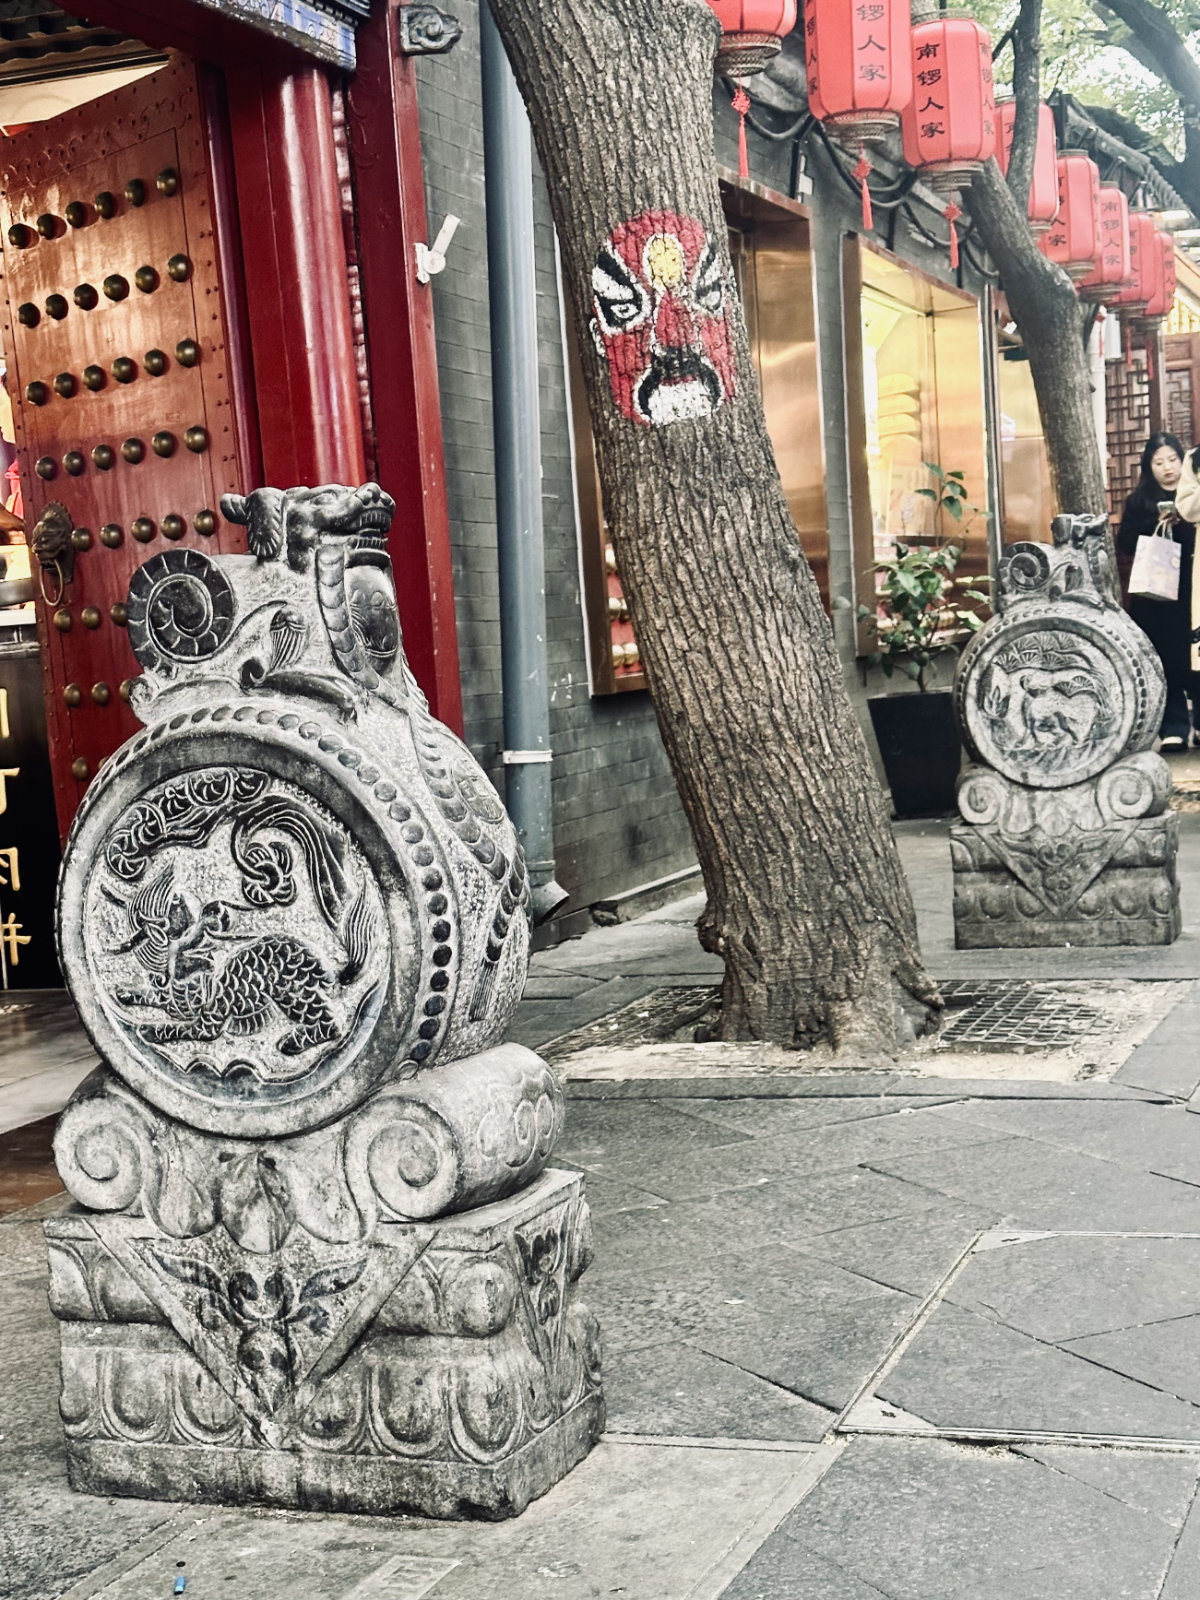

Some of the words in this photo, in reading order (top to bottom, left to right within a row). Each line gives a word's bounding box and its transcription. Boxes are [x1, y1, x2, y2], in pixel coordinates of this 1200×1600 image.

[856, 4, 887, 81] 锣人家
[915, 43, 945, 138] 南锣人家
